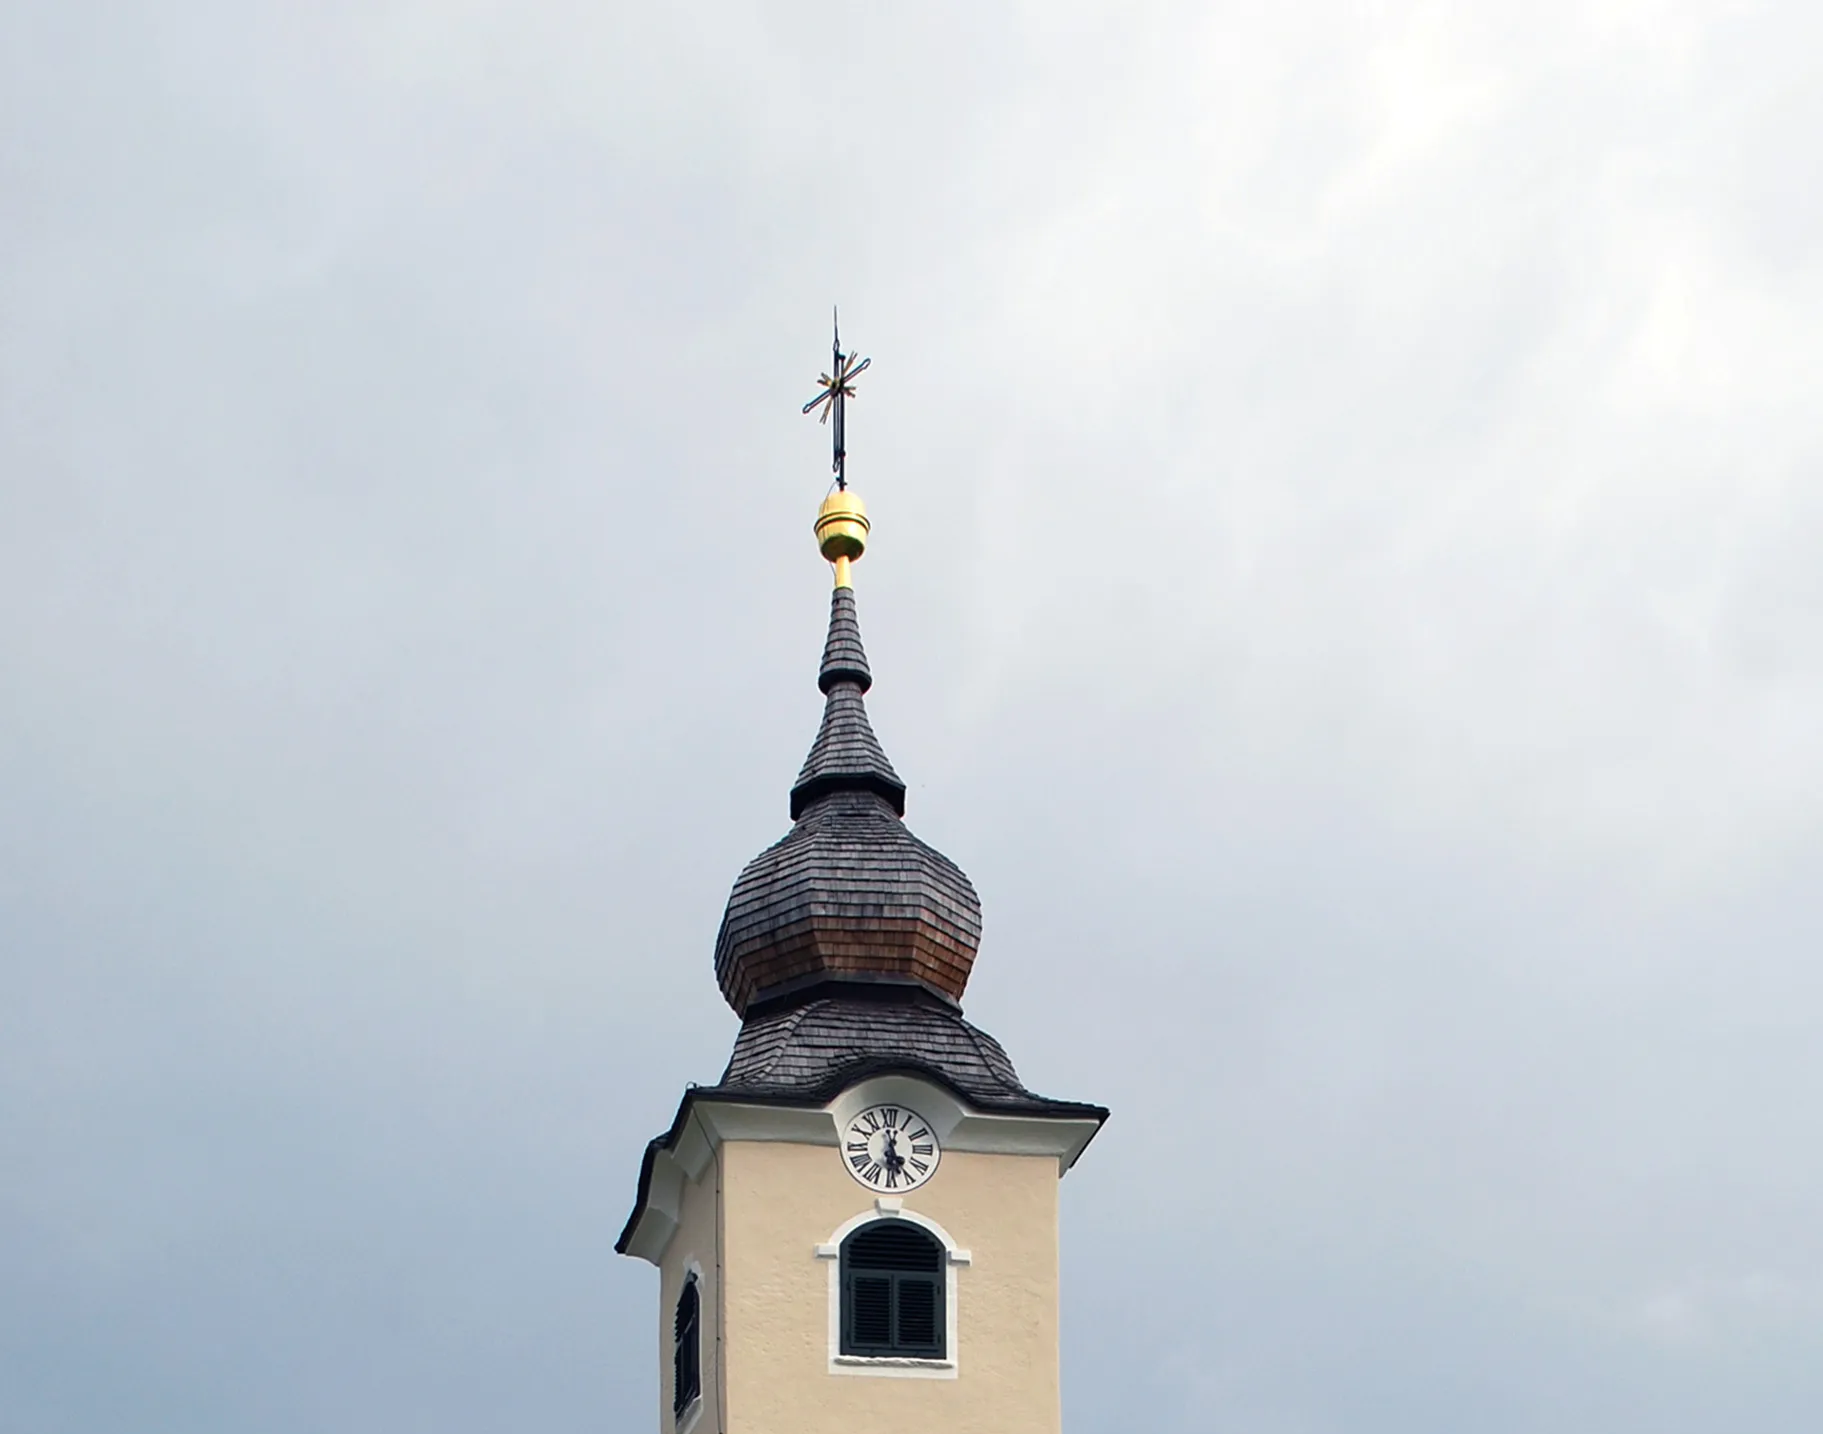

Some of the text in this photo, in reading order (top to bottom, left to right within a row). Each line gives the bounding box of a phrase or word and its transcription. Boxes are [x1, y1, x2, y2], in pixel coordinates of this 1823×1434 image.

[862, 1112, 881, 1132] XI
[881, 1108, 898, 1128] XII
[901, 1114, 913, 1131] I
[852, 1124, 872, 1140] X
[908, 1128, 929, 1142] II
[847, 1142, 868, 1152] IX
[912, 1144, 933, 1156] III
[849, 1154, 872, 1173] VIII
[909, 1157, 929, 1175] IV
[863, 1163, 881, 1184] VII
[901, 1167, 916, 1185] V
